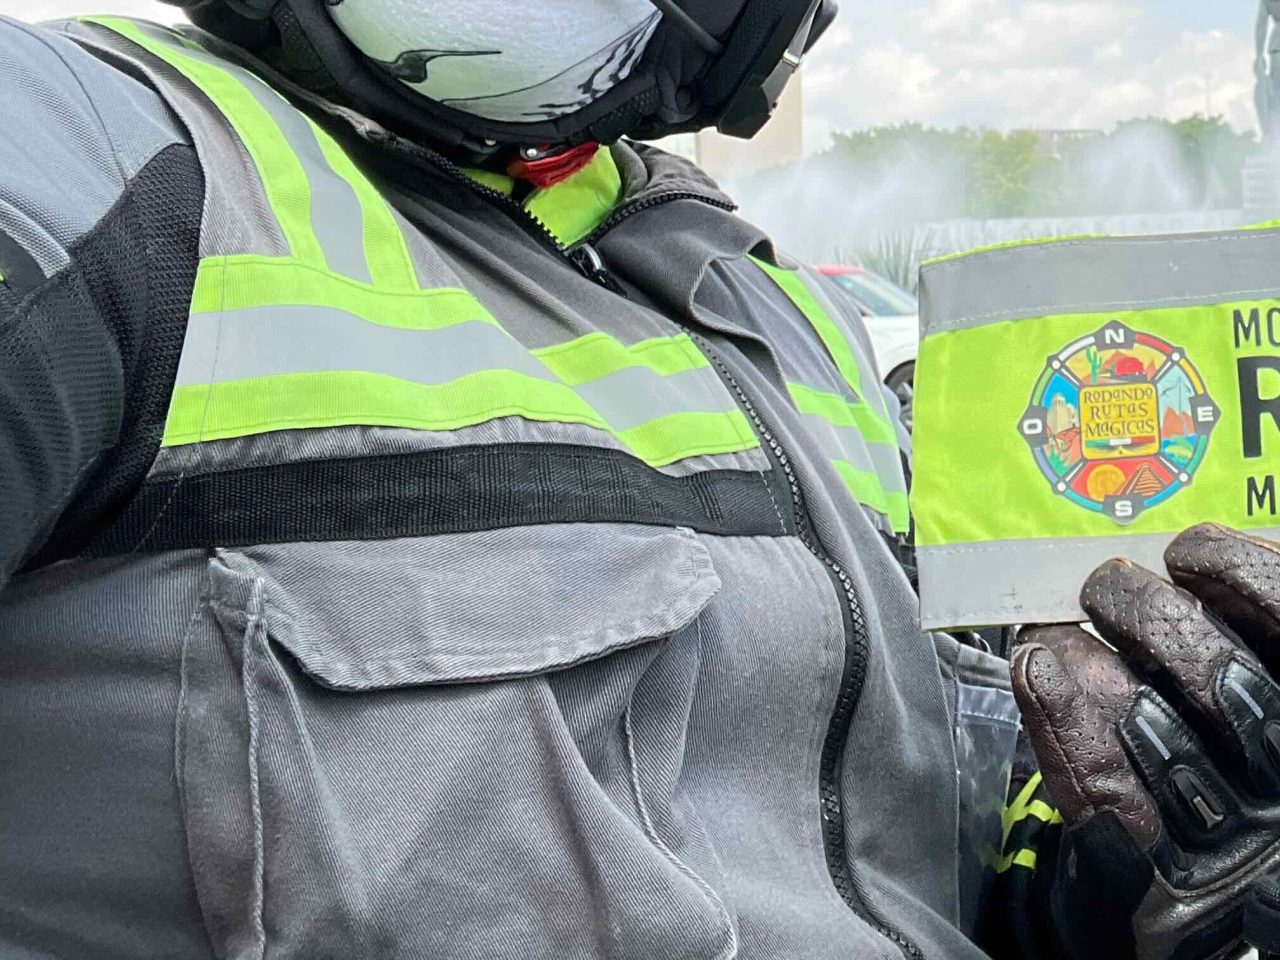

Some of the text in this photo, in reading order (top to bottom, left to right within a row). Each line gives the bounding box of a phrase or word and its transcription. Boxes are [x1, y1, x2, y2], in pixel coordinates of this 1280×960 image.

[1104, 328, 1125, 344] N
[1196, 406, 1214, 422] E
[1023, 418, 1043, 435] O
[1114, 500, 1133, 517] S
